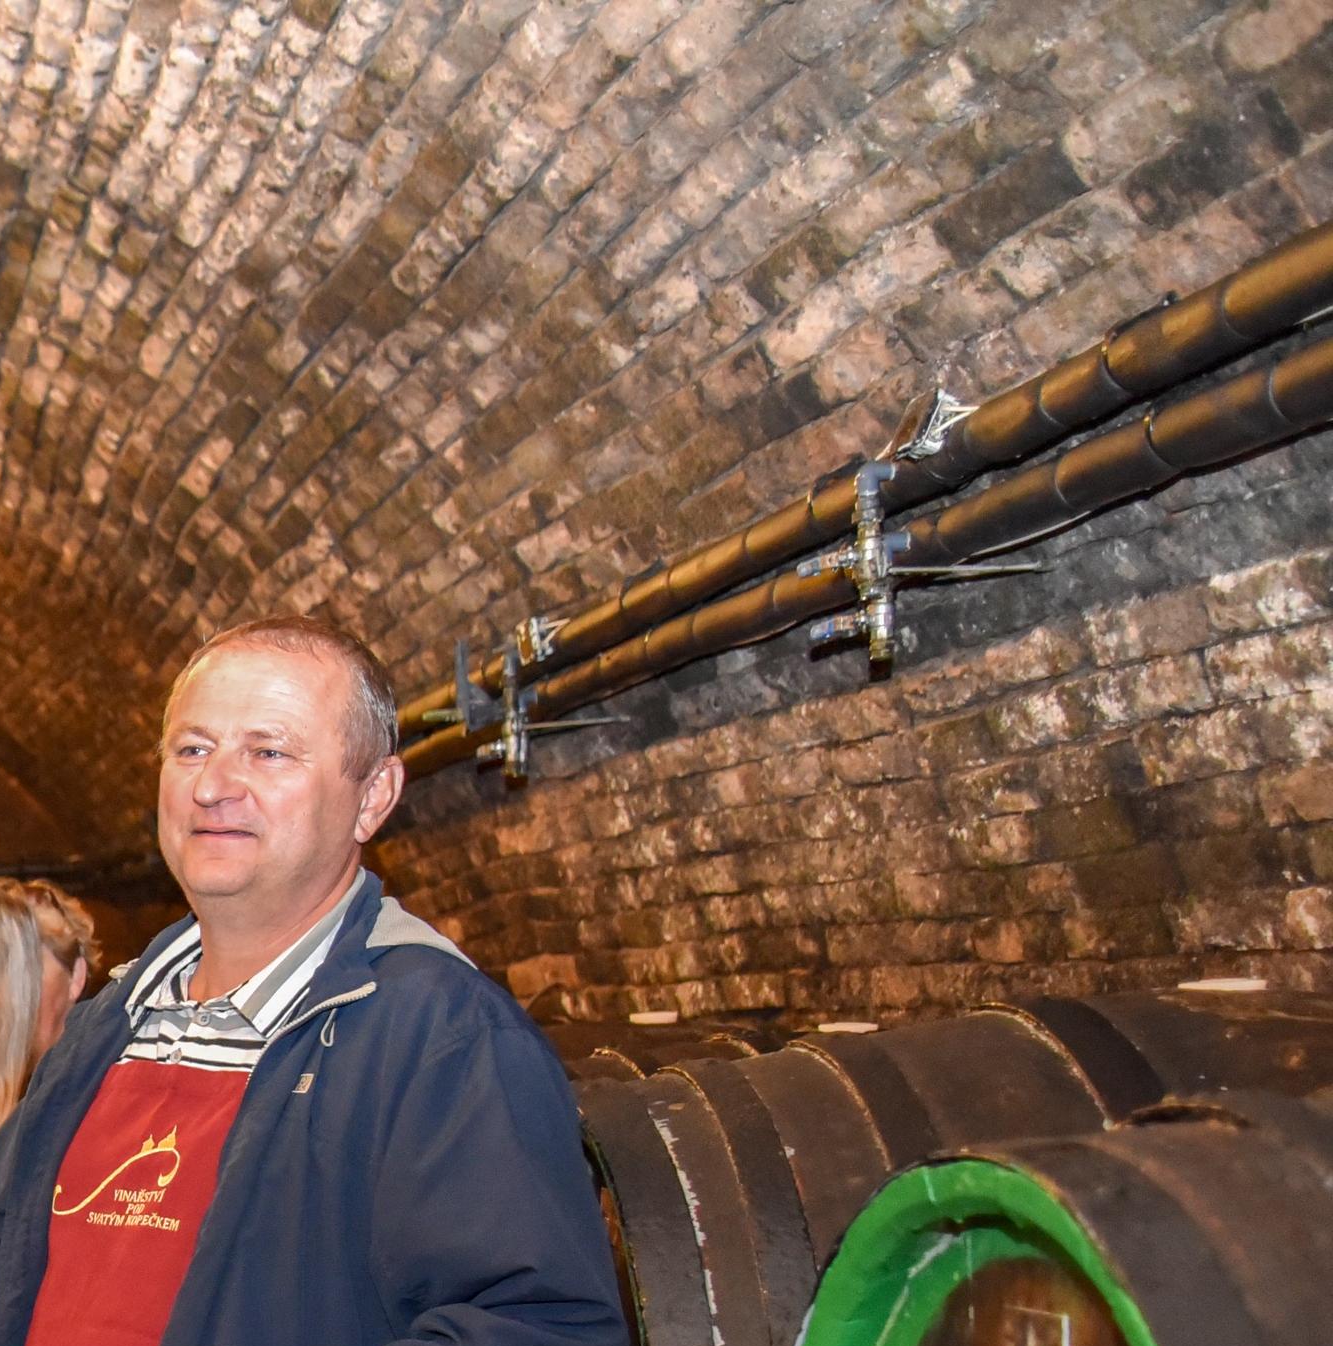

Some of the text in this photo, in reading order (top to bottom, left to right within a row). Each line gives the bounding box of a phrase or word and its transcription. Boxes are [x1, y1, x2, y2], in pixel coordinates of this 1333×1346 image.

[114, 1188, 166, 1203] VINAŘSTVÍ
[125, 1203, 145, 1215] POD
[86, 1211, 181, 1232] SVATÝM KOPEČKEM
